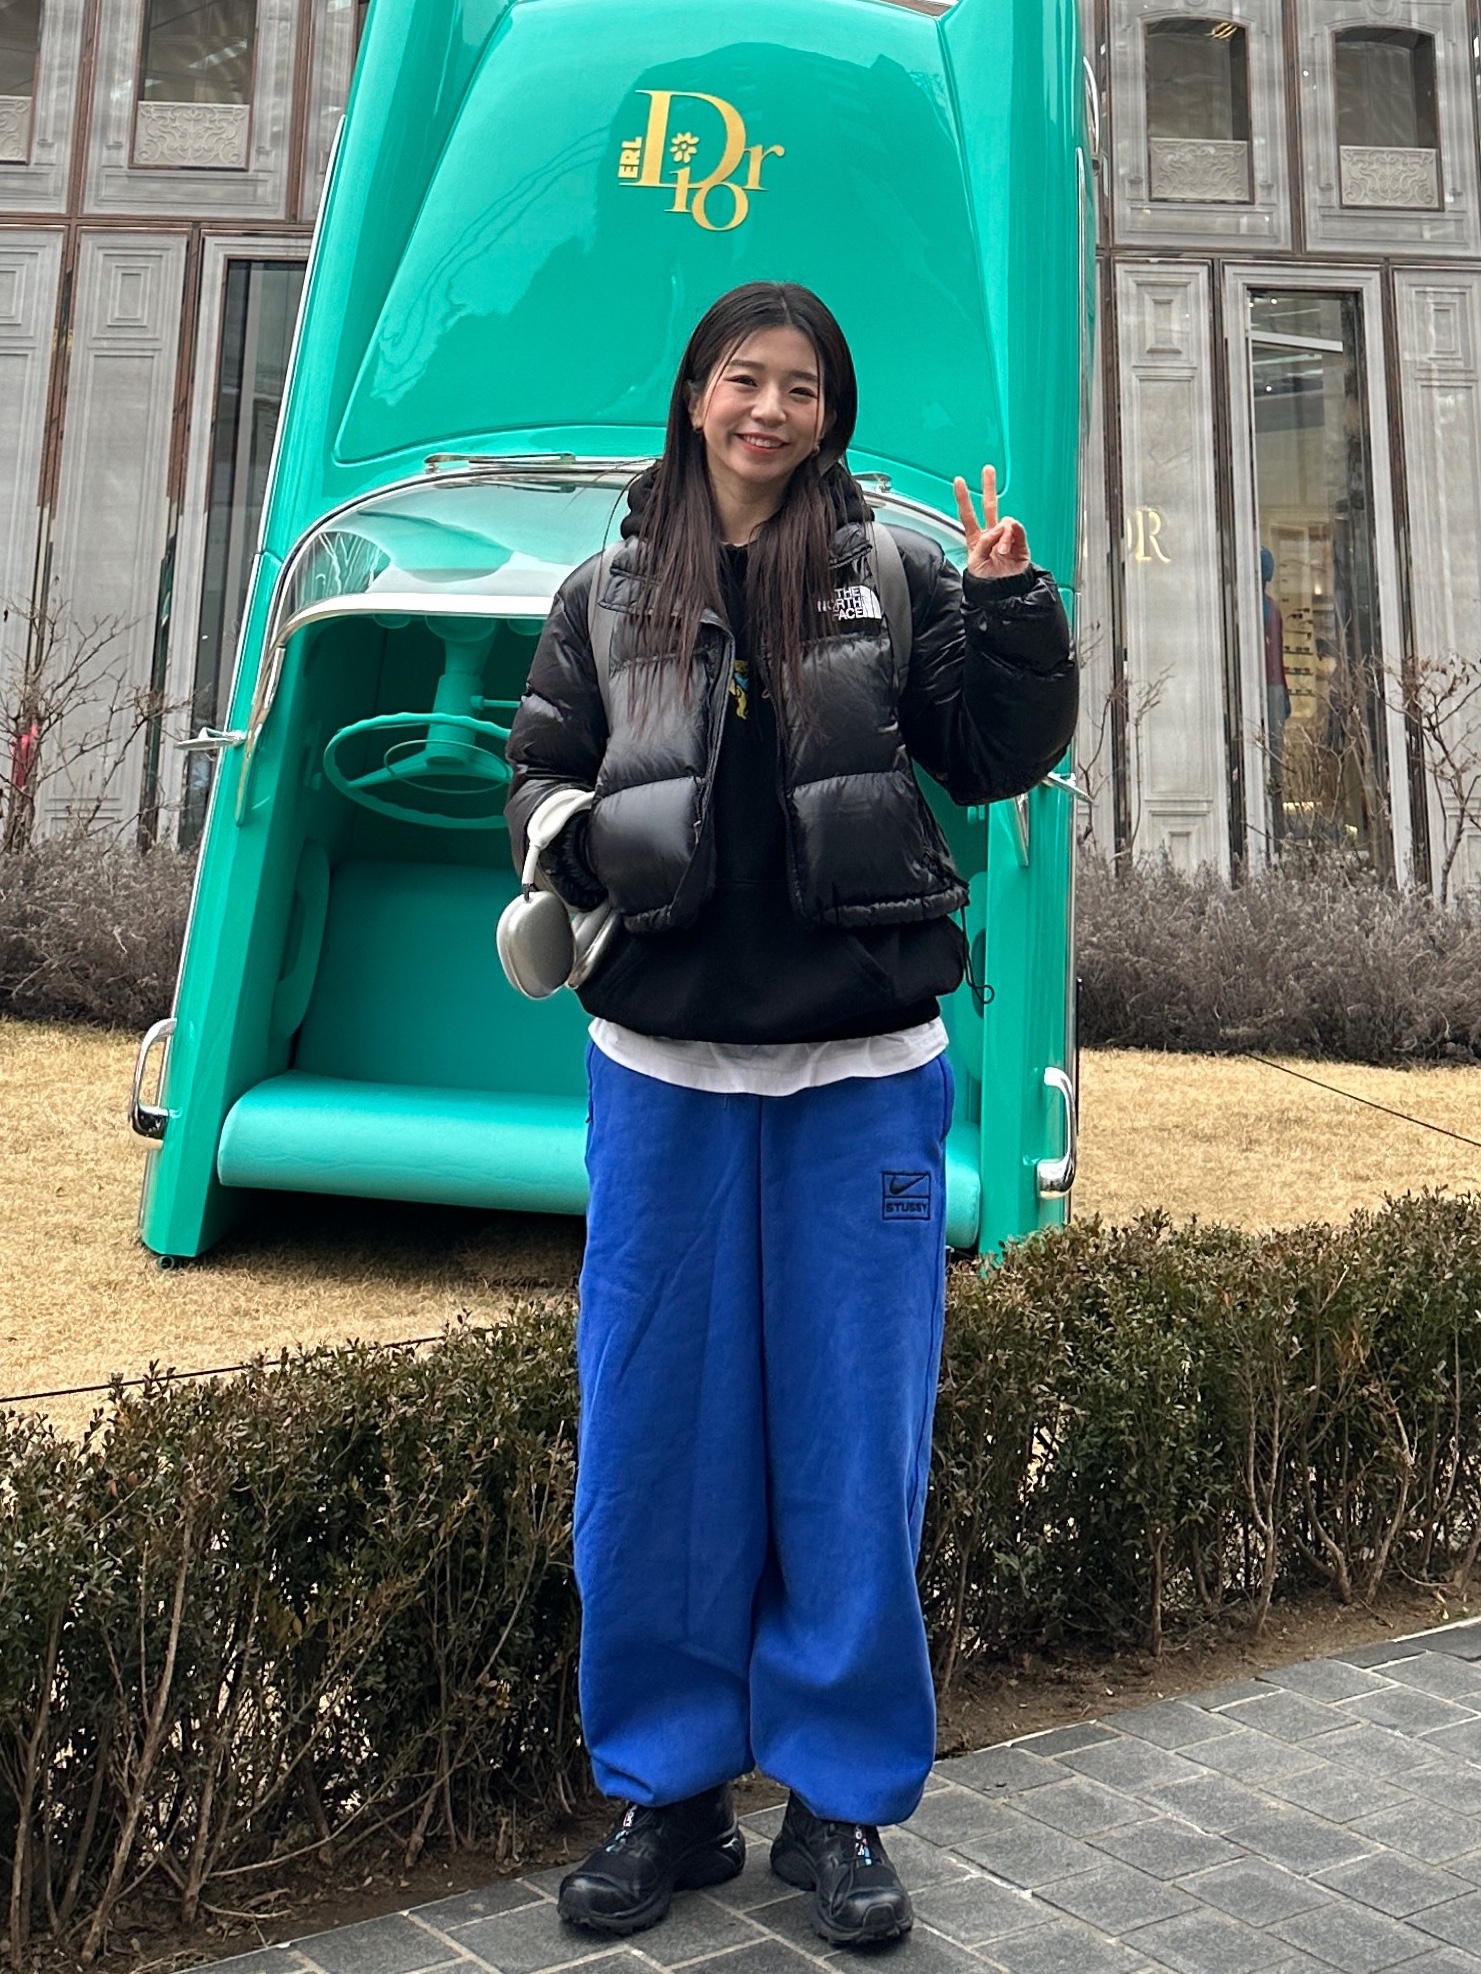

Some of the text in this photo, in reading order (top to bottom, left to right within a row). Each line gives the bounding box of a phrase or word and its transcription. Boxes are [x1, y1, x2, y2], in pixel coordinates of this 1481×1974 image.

[618, 136, 643, 179] ERL
[619, 89, 785, 231] Dior
[834, 586, 861, 599] THE
